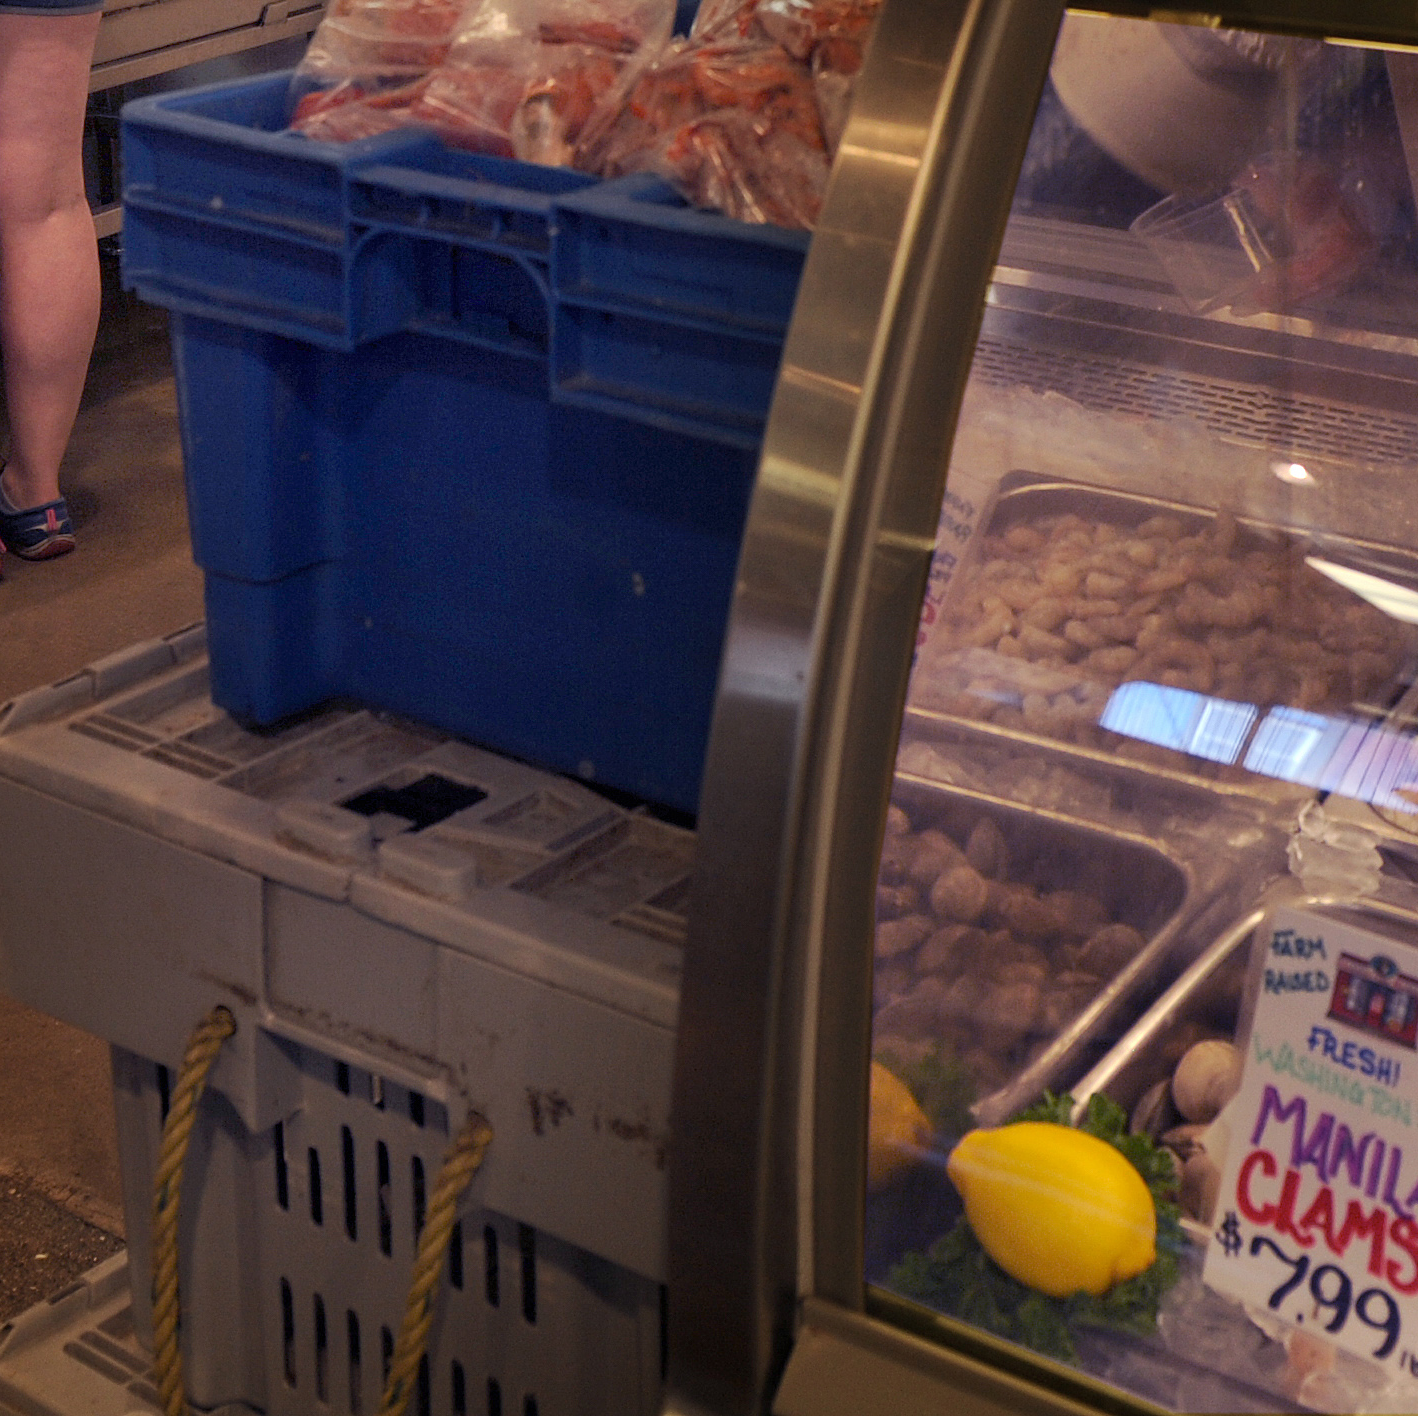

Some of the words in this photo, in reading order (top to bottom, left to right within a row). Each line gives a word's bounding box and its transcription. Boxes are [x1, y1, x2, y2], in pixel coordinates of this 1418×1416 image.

[1270, 929, 1329, 960] FARM
[1264, 968, 1332, 996] RAISED
[1253, 1033, 1412, 1128] WASHINGTON
[1306, 1025, 1402, 1088] FRESH!
[1215, 1210, 1402, 1360] $7.99
